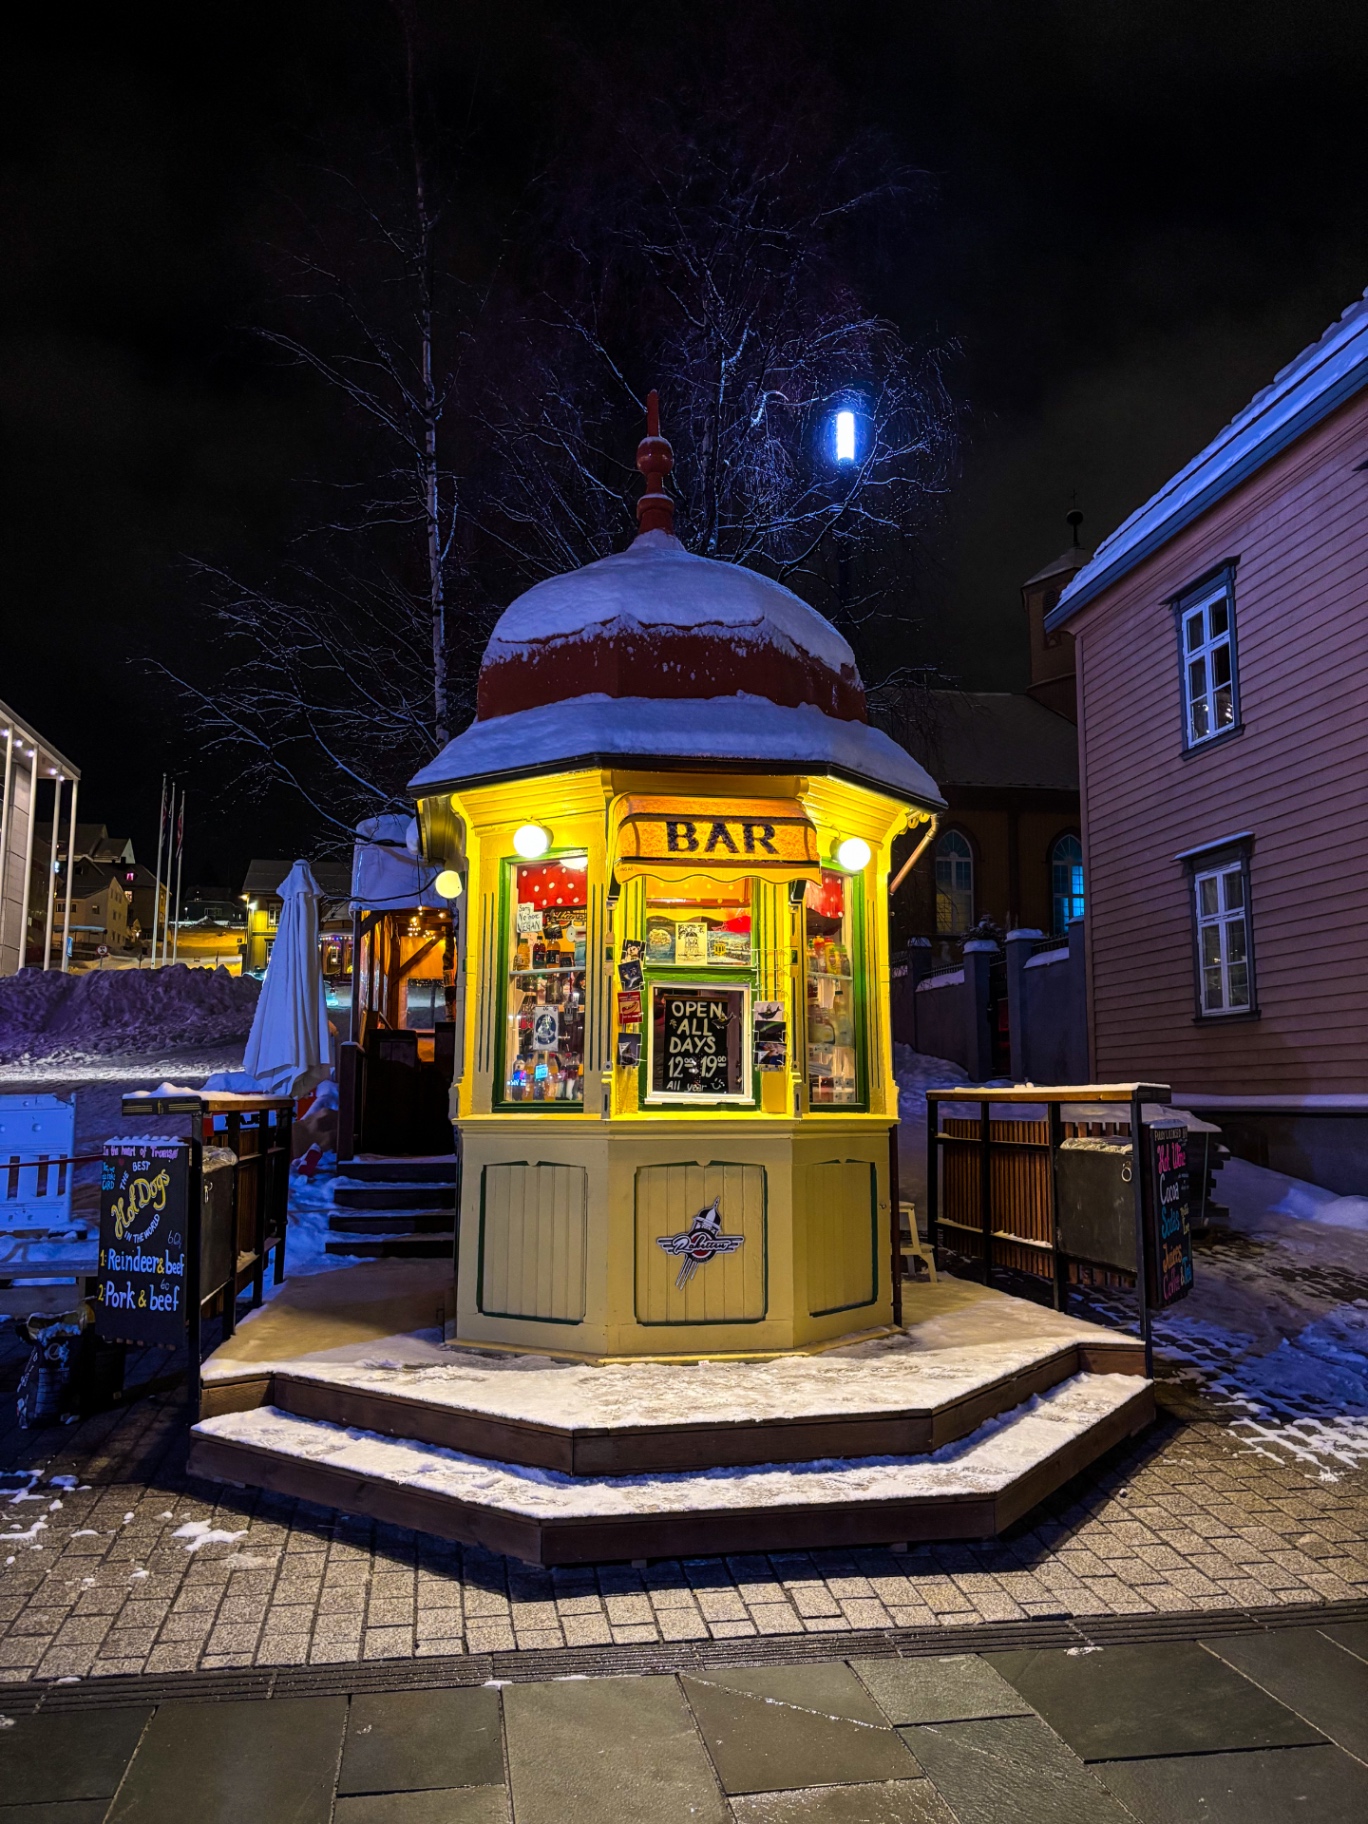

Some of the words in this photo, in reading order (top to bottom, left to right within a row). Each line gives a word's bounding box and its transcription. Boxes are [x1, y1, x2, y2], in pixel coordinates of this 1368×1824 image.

[666, 821, 780, 855] BAR
[516, 919, 541, 932] VEGAN
[671, 1001, 723, 1020] OPEN
[676, 1017, 713, 1036] ALL
[669, 1036, 717, 1054] DAYS
[666, 1079, 681, 1091] All
[686, 1081, 708, 1093] year
[110, 1145, 119, 1157] the
[121, 1145, 136, 1157] heart
[139, 1145, 147, 1159] of
[132, 1160, 151, 1172] BEST
[1157, 1144, 1171, 1174] Hot
[1172, 1141, 1187, 1169] Wine
[119, 1169, 130, 1191] THE
[1159, 1172, 1180, 1206] Cocoa
[110, 1183, 140, 1241] Hot
[133, 1168, 171, 1211] Dogs
[123, 1229, 133, 1243] IN
[132, 1231, 145, 1244] THE
[143, 1213, 161, 1240] WORLD
[1161, 1205, 1180, 1239] Sodas
[107, 1245, 160, 1274] Reindeer
[156, 1257, 165, 1275] &
[165, 1248, 185, 1277] beef
[1162, 1242, 1183, 1274] Juices
[159, 1278, 170, 1291] 60
[1163, 1266, 1181, 1301] Coffee
[1182, 1256, 1192, 1285] Tea
[105, 1280, 137, 1310] Pork
[138, 1289, 147, 1308] &
[149, 1283, 180, 1312] beef
